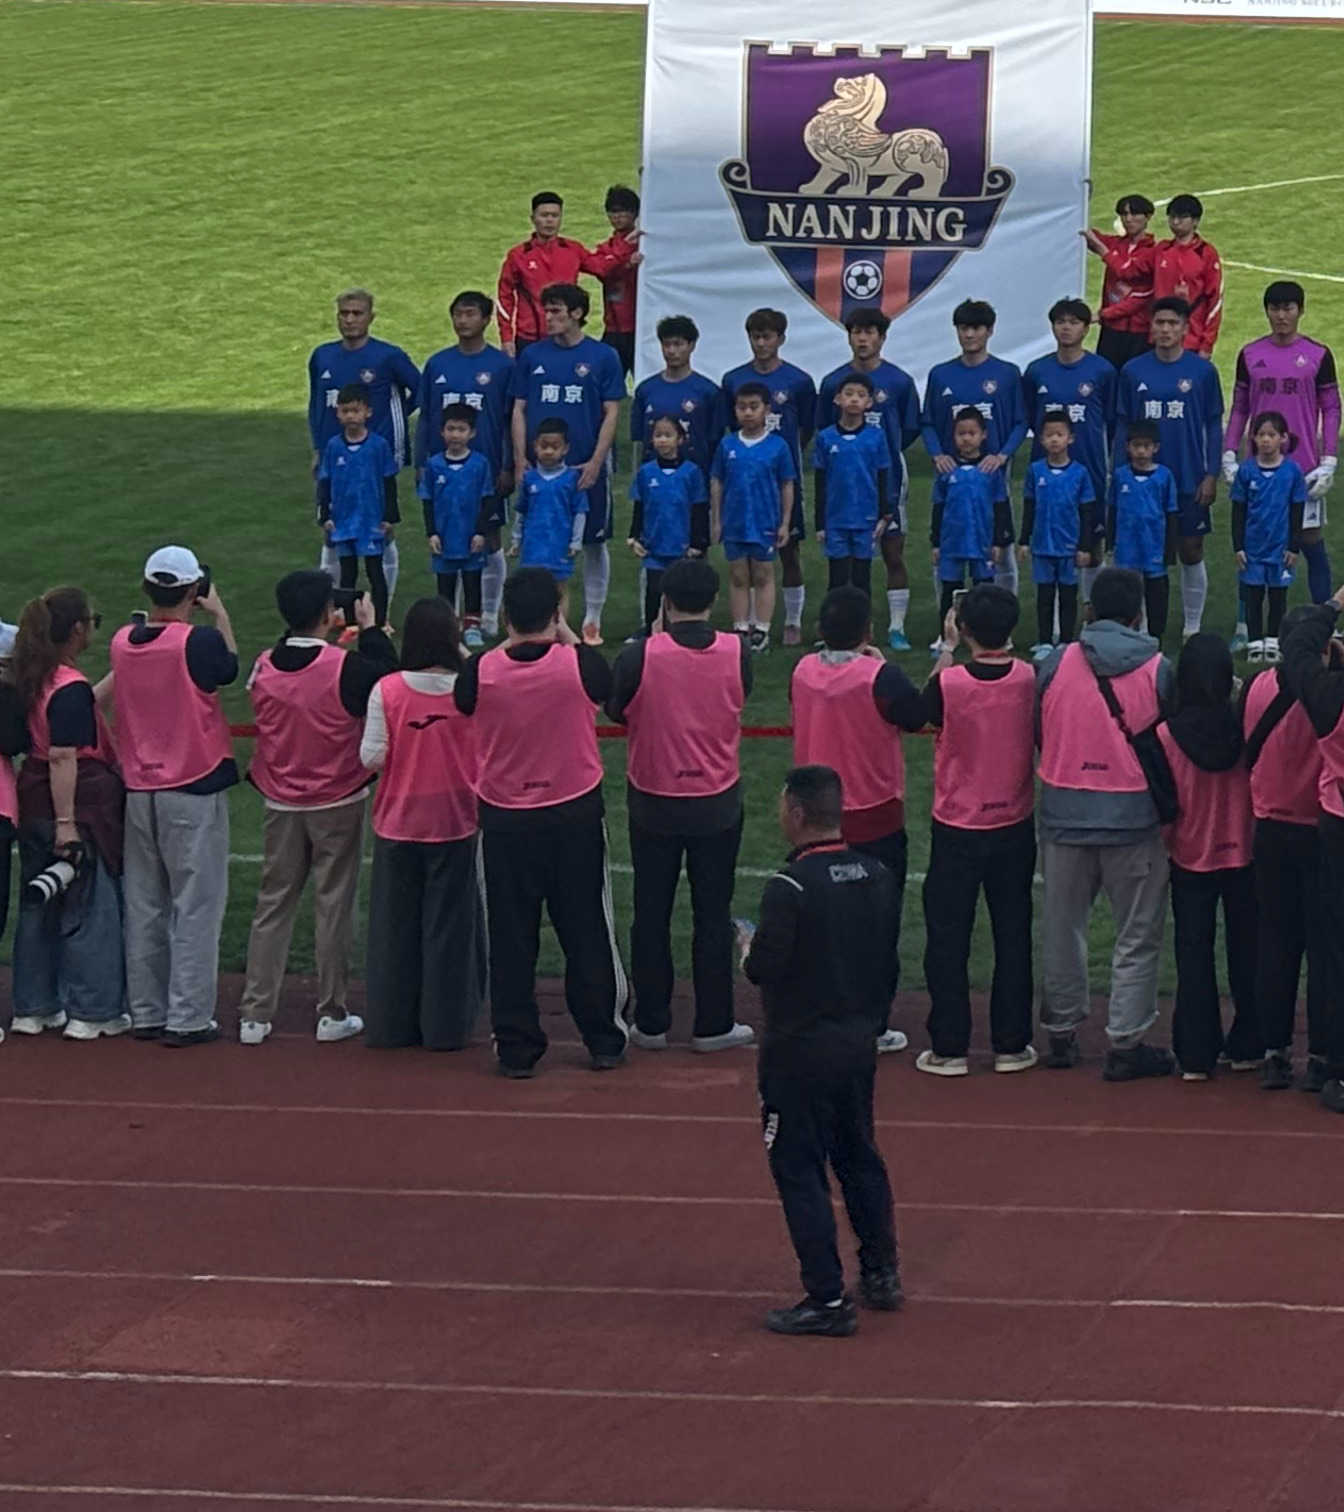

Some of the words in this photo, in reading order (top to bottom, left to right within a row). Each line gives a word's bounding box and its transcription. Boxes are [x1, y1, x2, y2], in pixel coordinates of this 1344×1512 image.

[765, 200, 968, 243] NANJING
[540, 383, 584, 404] 南京
[1259, 377, 1301, 395] 南京
[1144, 399, 1185, 419] 南京
